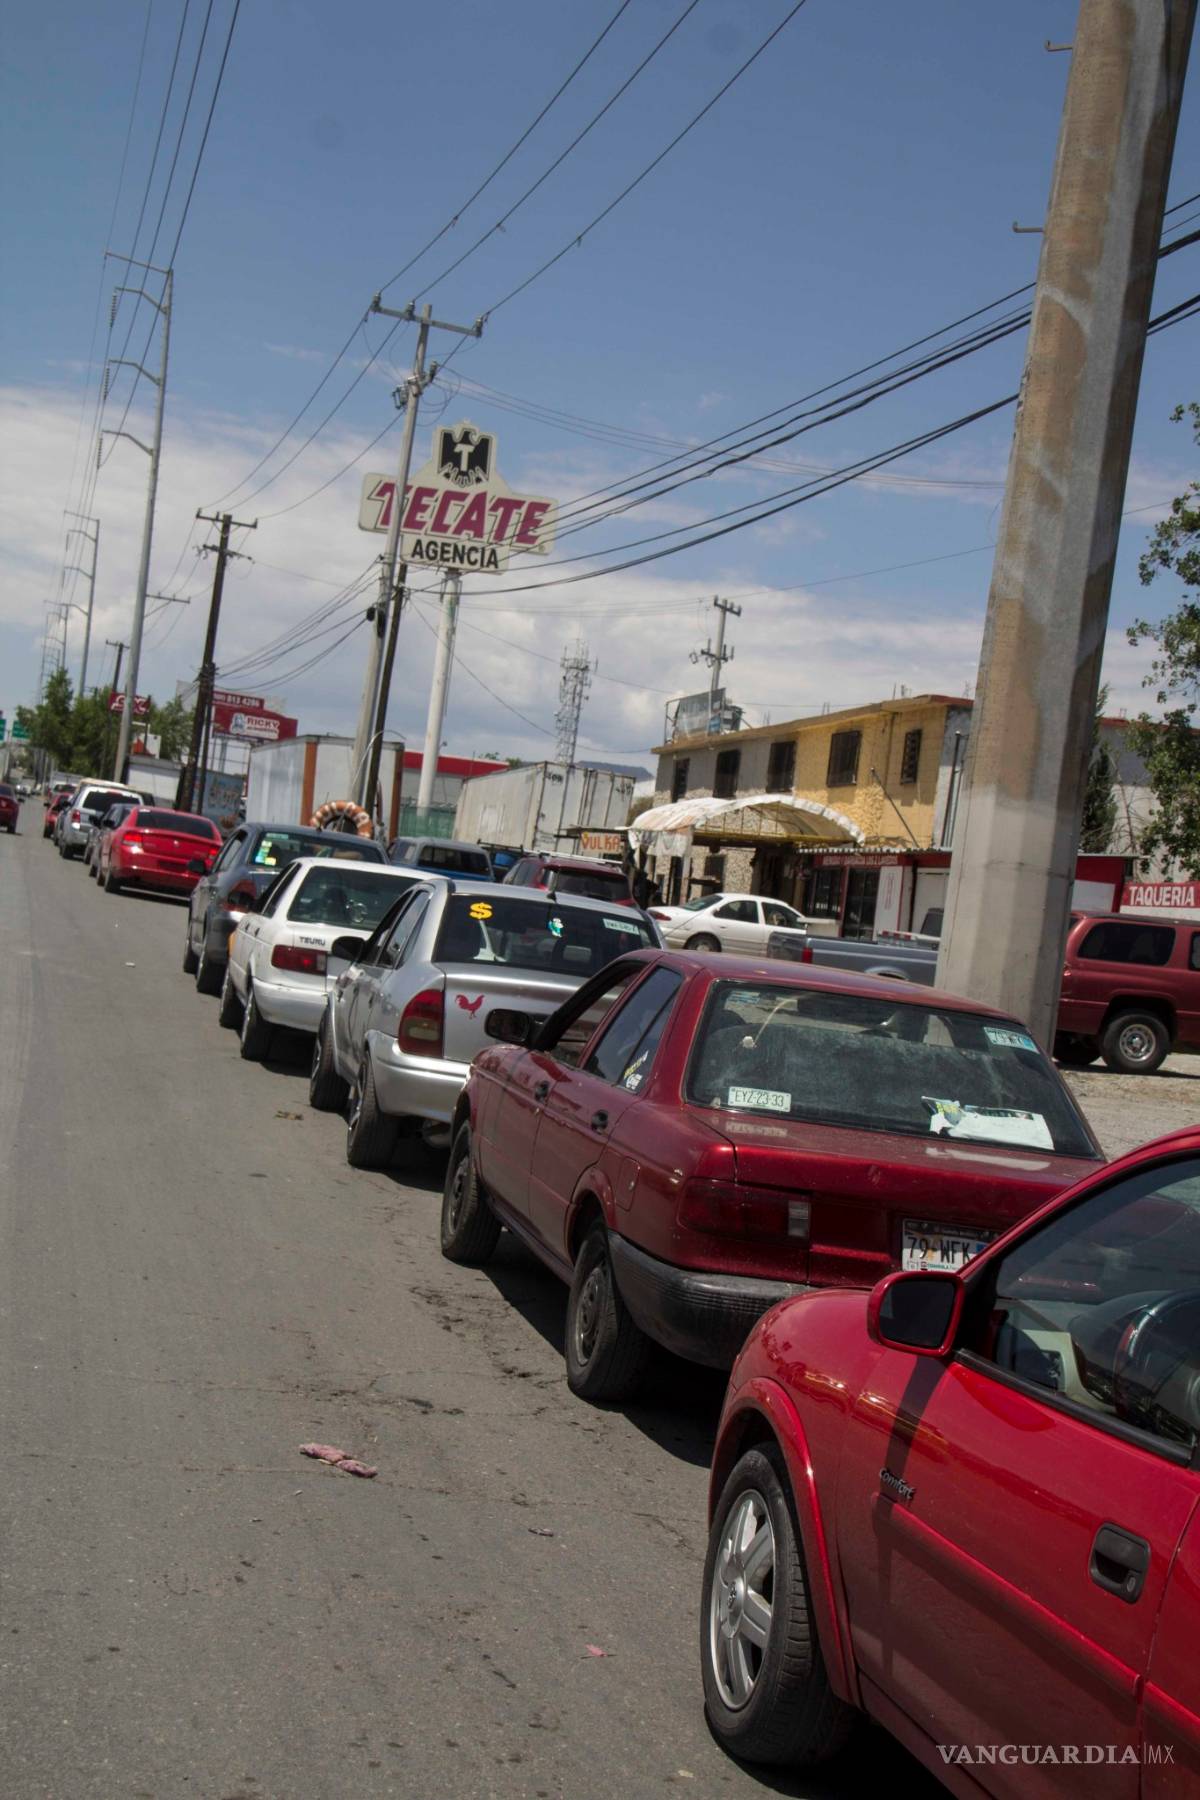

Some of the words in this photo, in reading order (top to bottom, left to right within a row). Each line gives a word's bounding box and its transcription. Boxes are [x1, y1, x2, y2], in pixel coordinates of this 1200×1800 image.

[375, 482, 552, 545] TECATE
[411, 539, 499, 569] AGENCIA
[247, 717, 279, 729] RICKY
[1129, 886, 1195, 907] TAQUERIA
